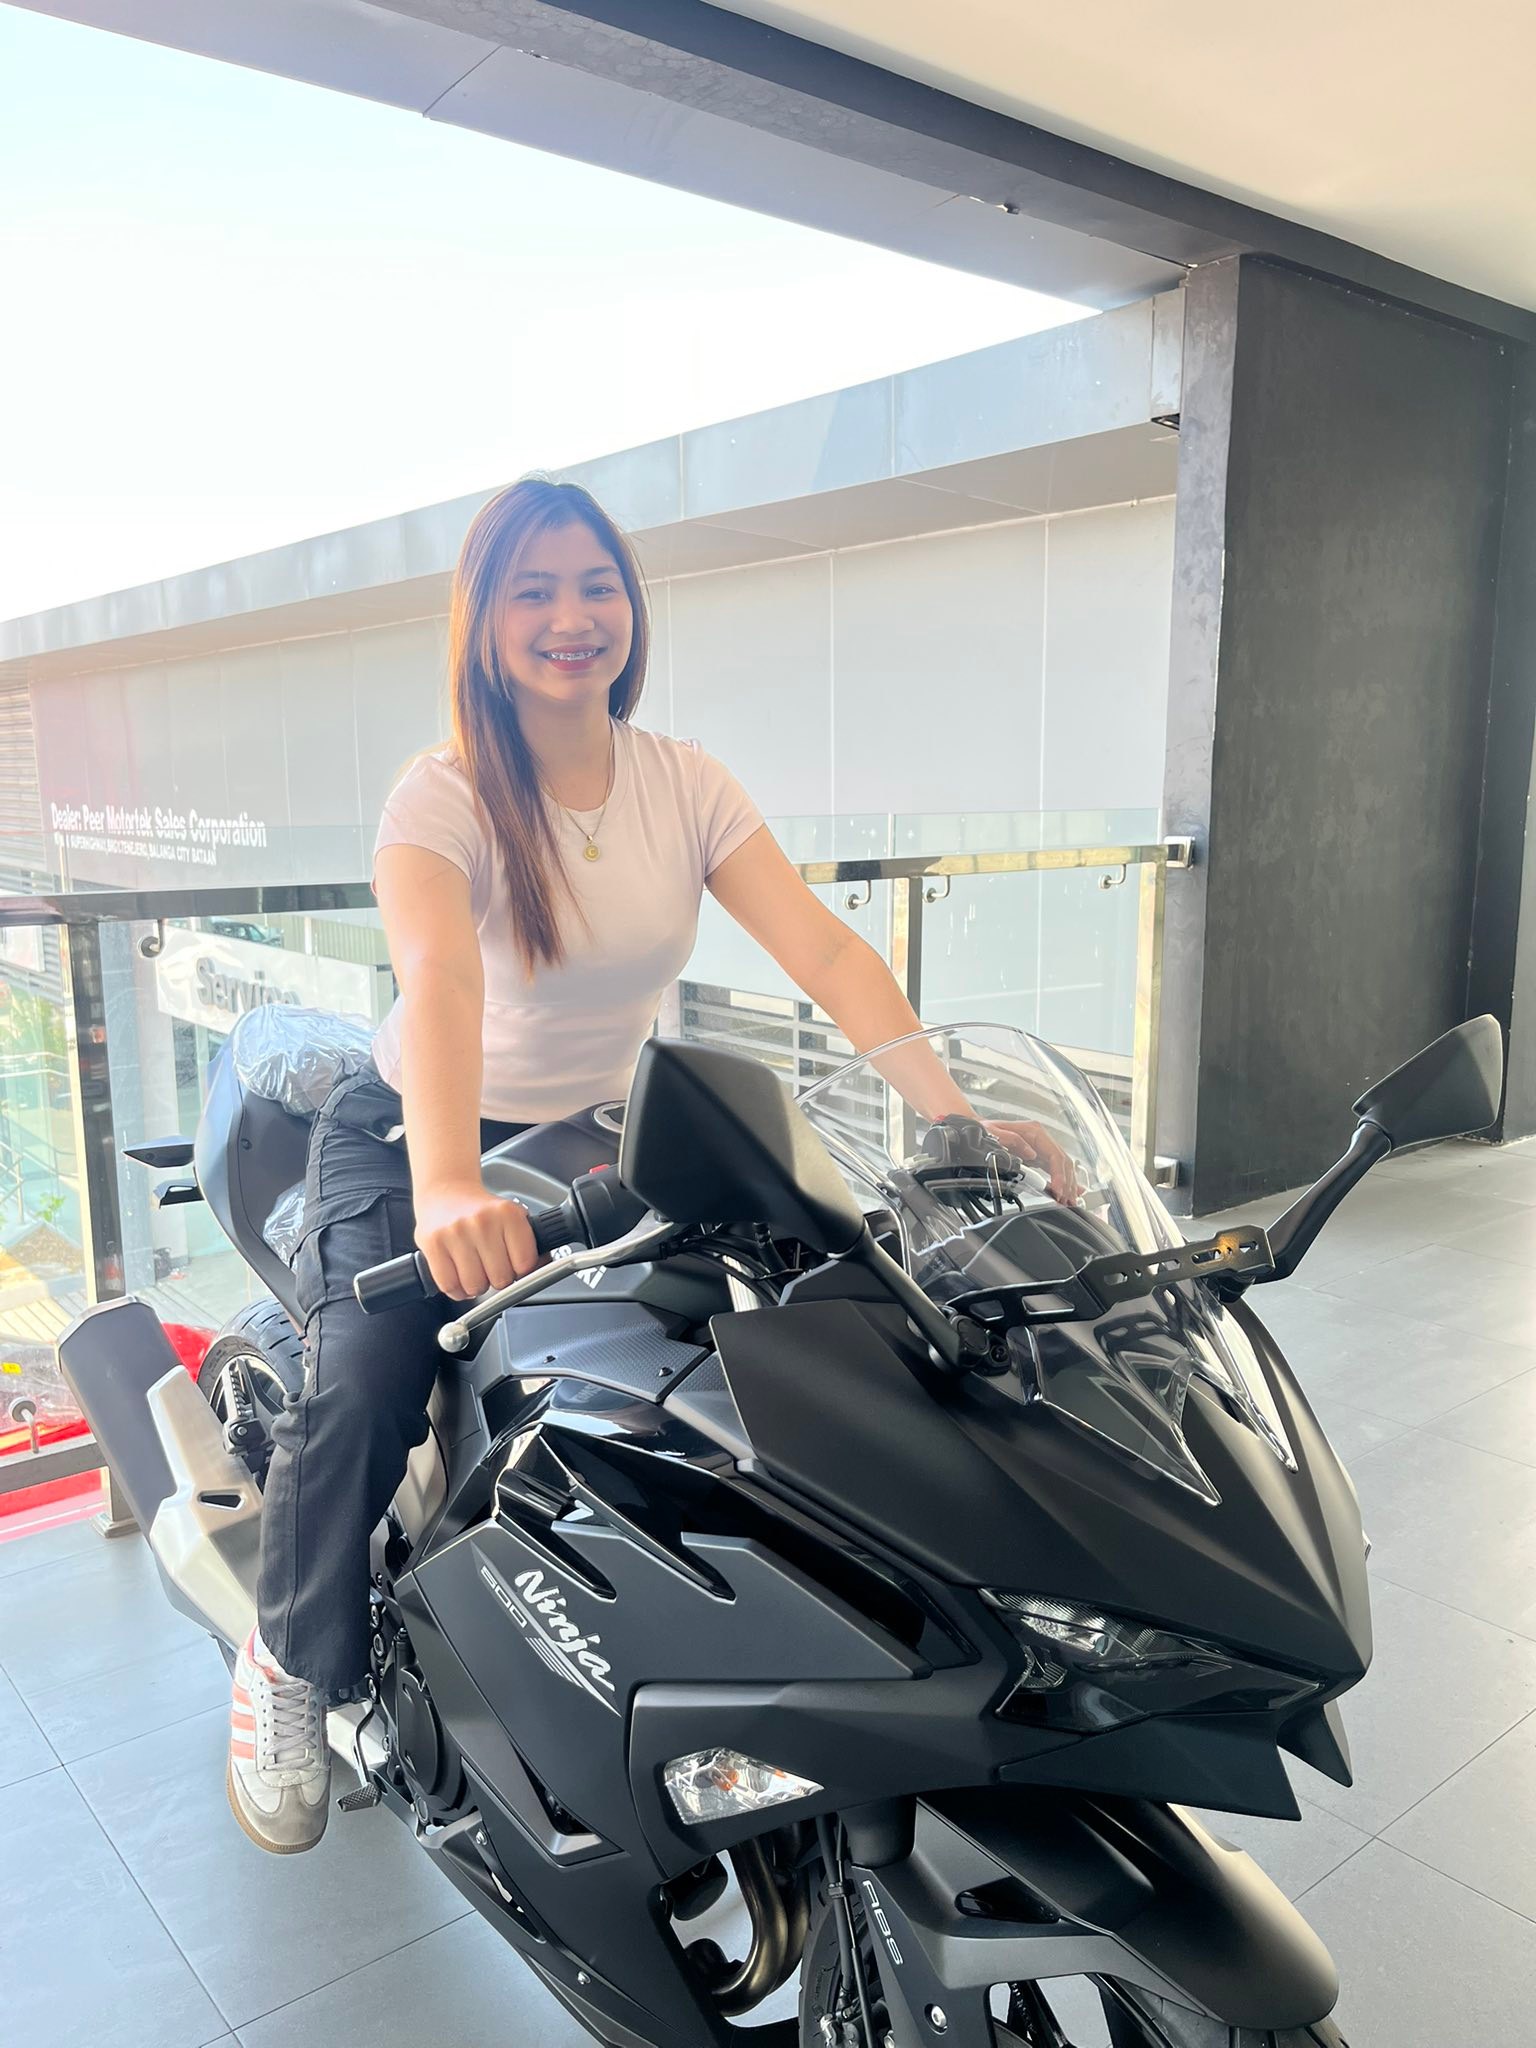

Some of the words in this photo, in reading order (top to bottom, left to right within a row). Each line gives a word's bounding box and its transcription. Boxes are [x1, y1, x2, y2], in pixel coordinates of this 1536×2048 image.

[51, 802, 82, 831] Dealer:
[82, 804, 105, 833] Peer
[105, 804, 154, 838] Motortek
[155, 806, 187, 841] Sales
[189, 808, 267, 850] Corporation
[480, 1565, 528, 1629] 500
[514, 1569, 616, 1692] Ninja
[862, 1879, 904, 1965] ABS
